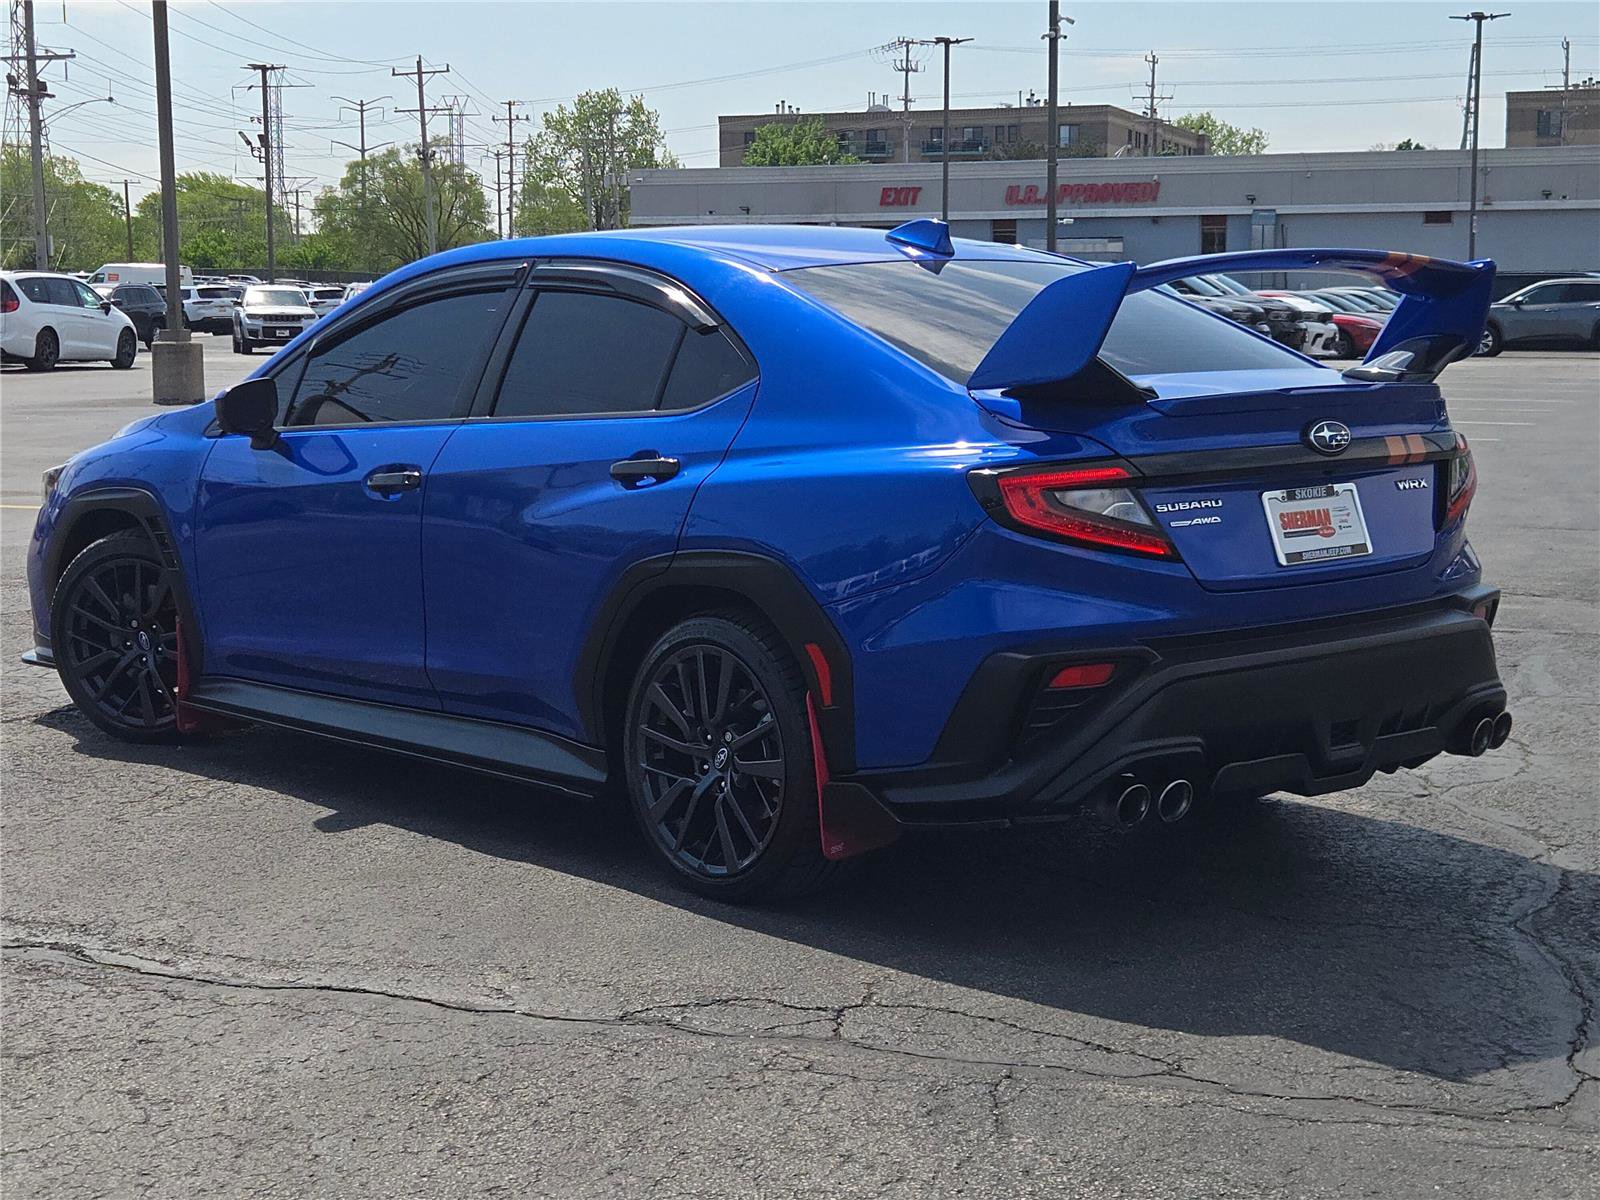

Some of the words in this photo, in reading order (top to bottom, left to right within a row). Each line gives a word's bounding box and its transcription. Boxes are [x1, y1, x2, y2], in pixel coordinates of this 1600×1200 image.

[880, 186, 922, 206] EXIT
[1396, 479, 1428, 490] WRX
[1295, 488, 1327, 500] SKOKIE
[1156, 499, 1223, 513] SUBARU
[1190, 516, 1222, 526] AWD
[1279, 508, 1332, 530] SHERMAN
